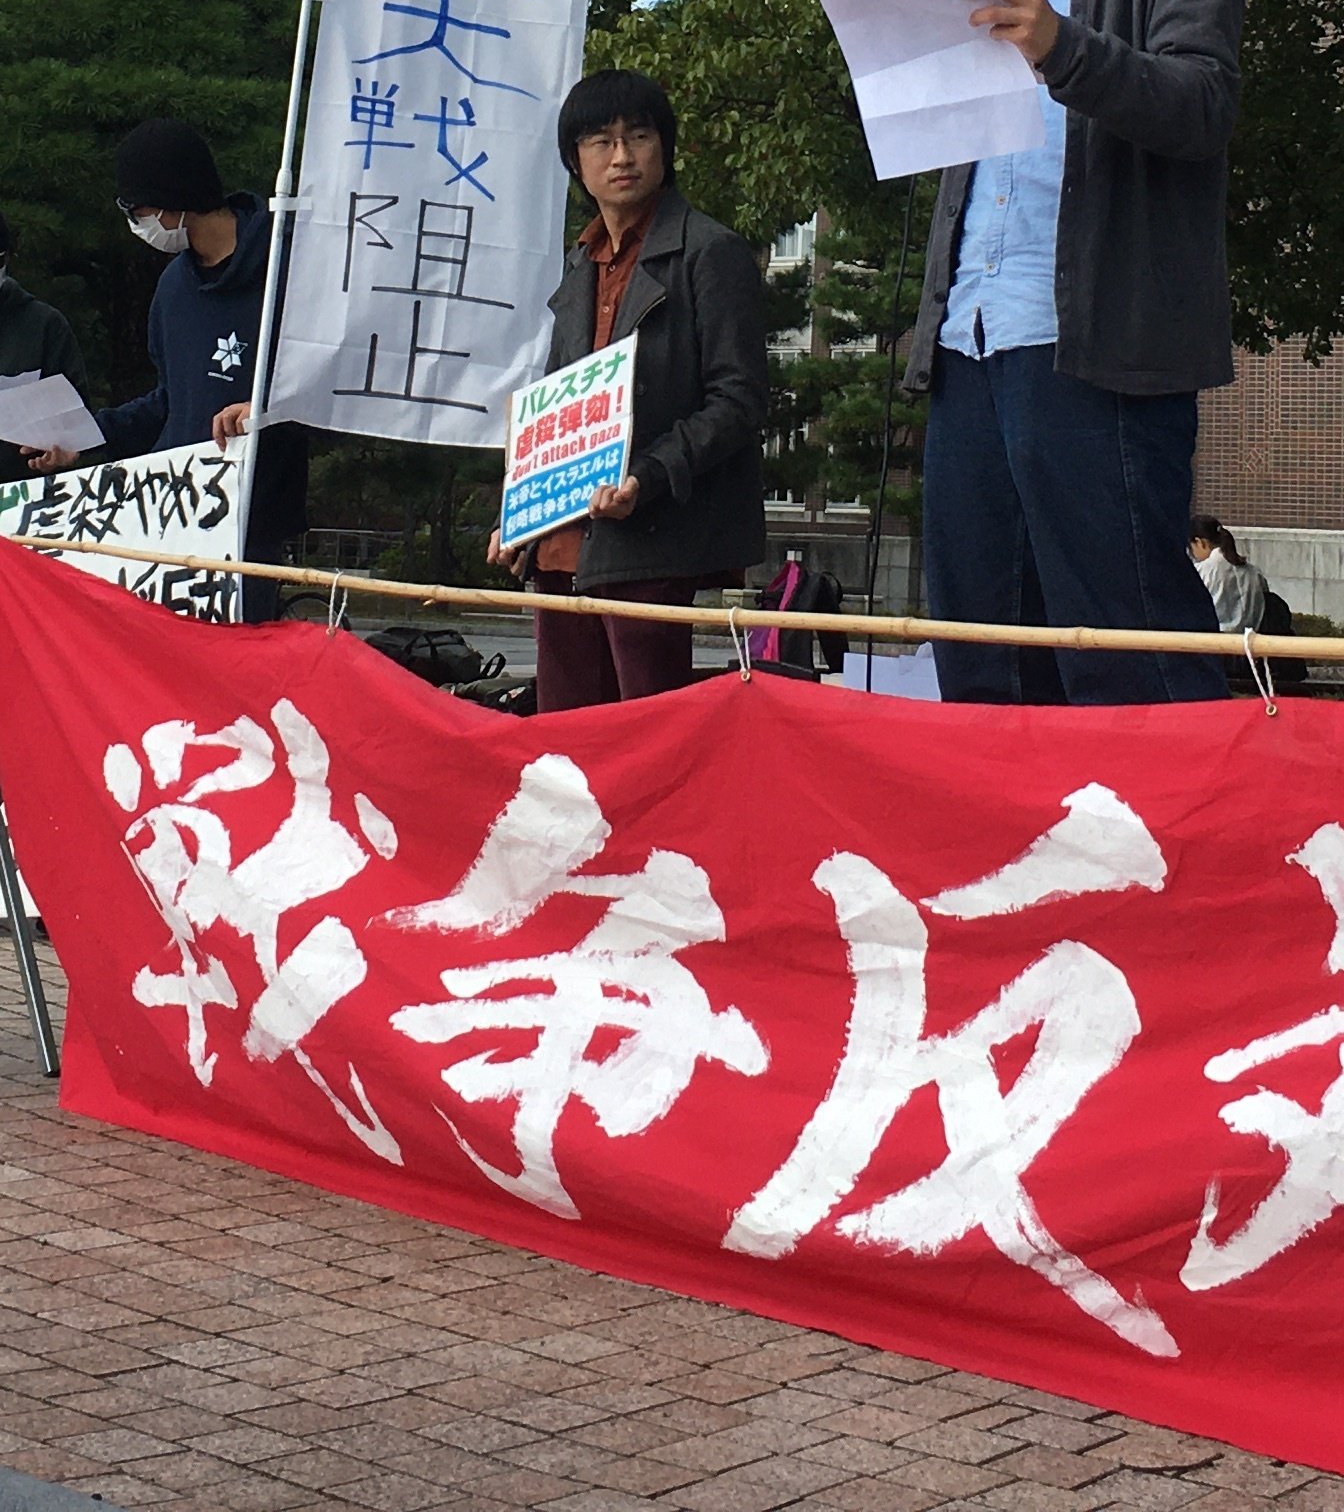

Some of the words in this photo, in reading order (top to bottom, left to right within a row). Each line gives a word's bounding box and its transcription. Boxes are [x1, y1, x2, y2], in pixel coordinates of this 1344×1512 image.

[518, 350, 628, 424] パレスチナ
[541, 434, 587, 466] attack
[589, 423, 622, 450] gaza
